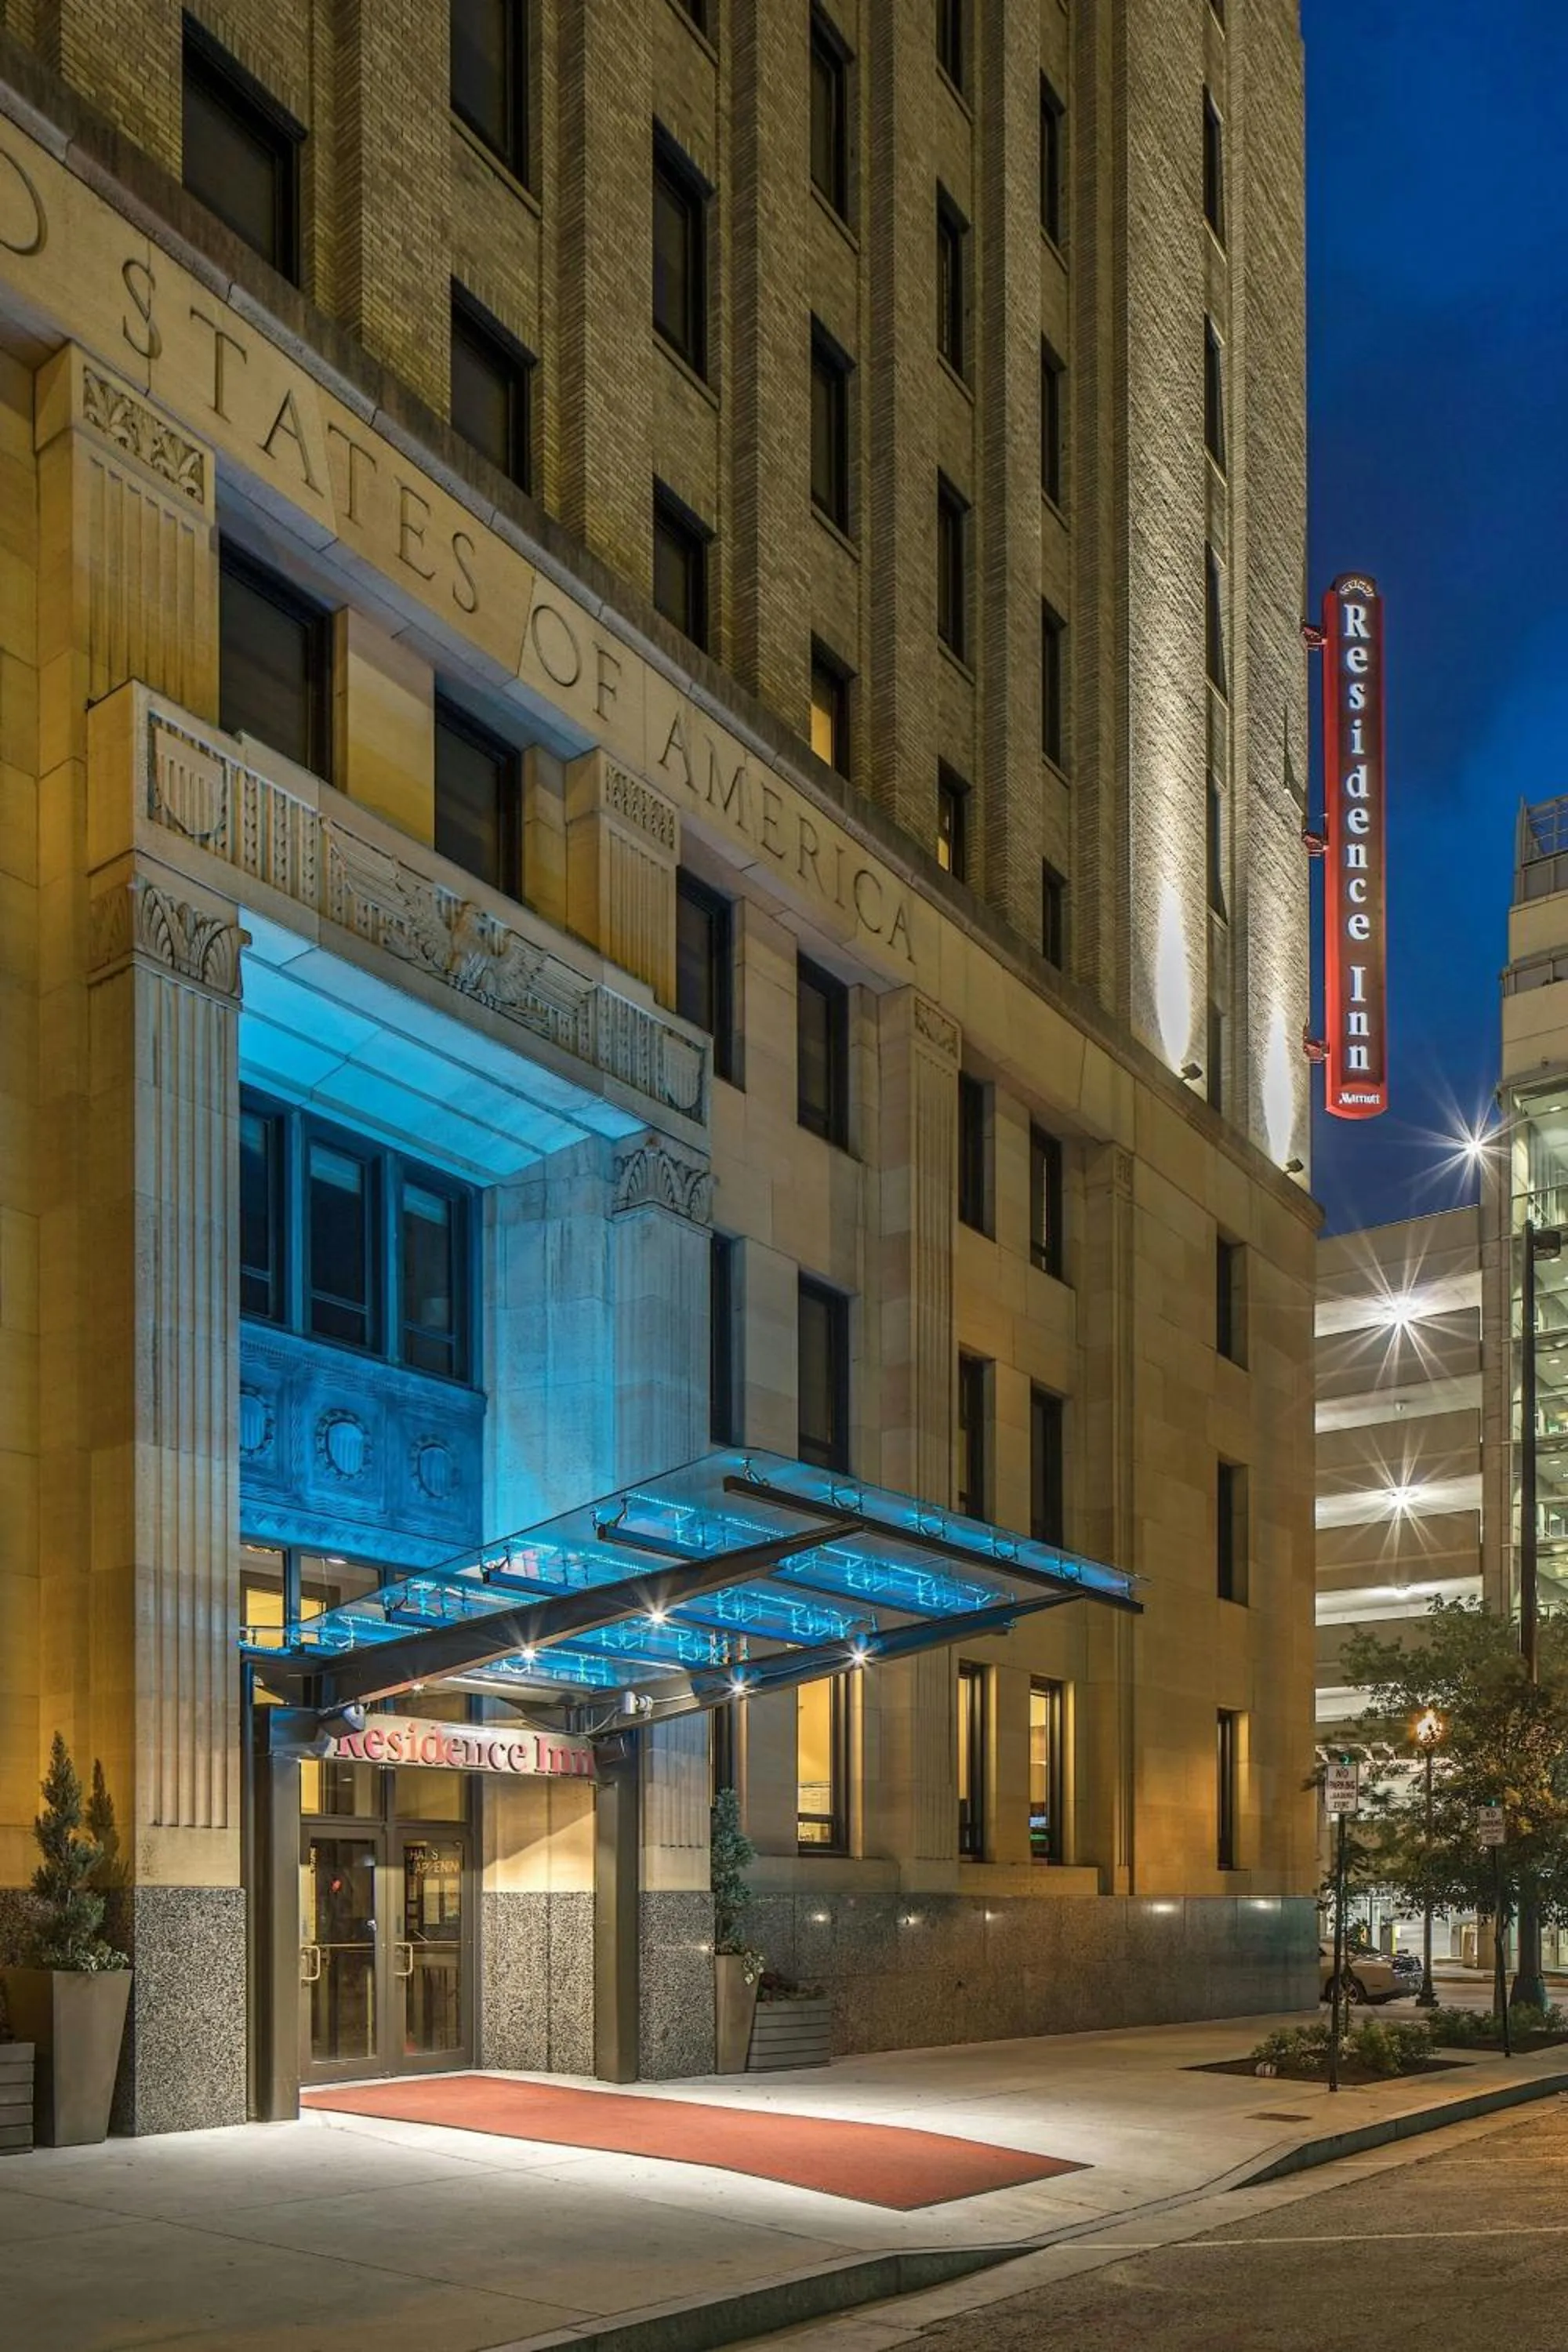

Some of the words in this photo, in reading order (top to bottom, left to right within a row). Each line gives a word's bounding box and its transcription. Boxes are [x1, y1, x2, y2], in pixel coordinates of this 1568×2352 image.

[121, 258, 477, 615] STATES
[531, 604, 622, 722] OF
[659, 710, 918, 965] AMERICA
[1343, 603, 1370, 940] Residence
[1347, 965, 1370, 1070] Inn
[334, 1721, 527, 1773] Residence
